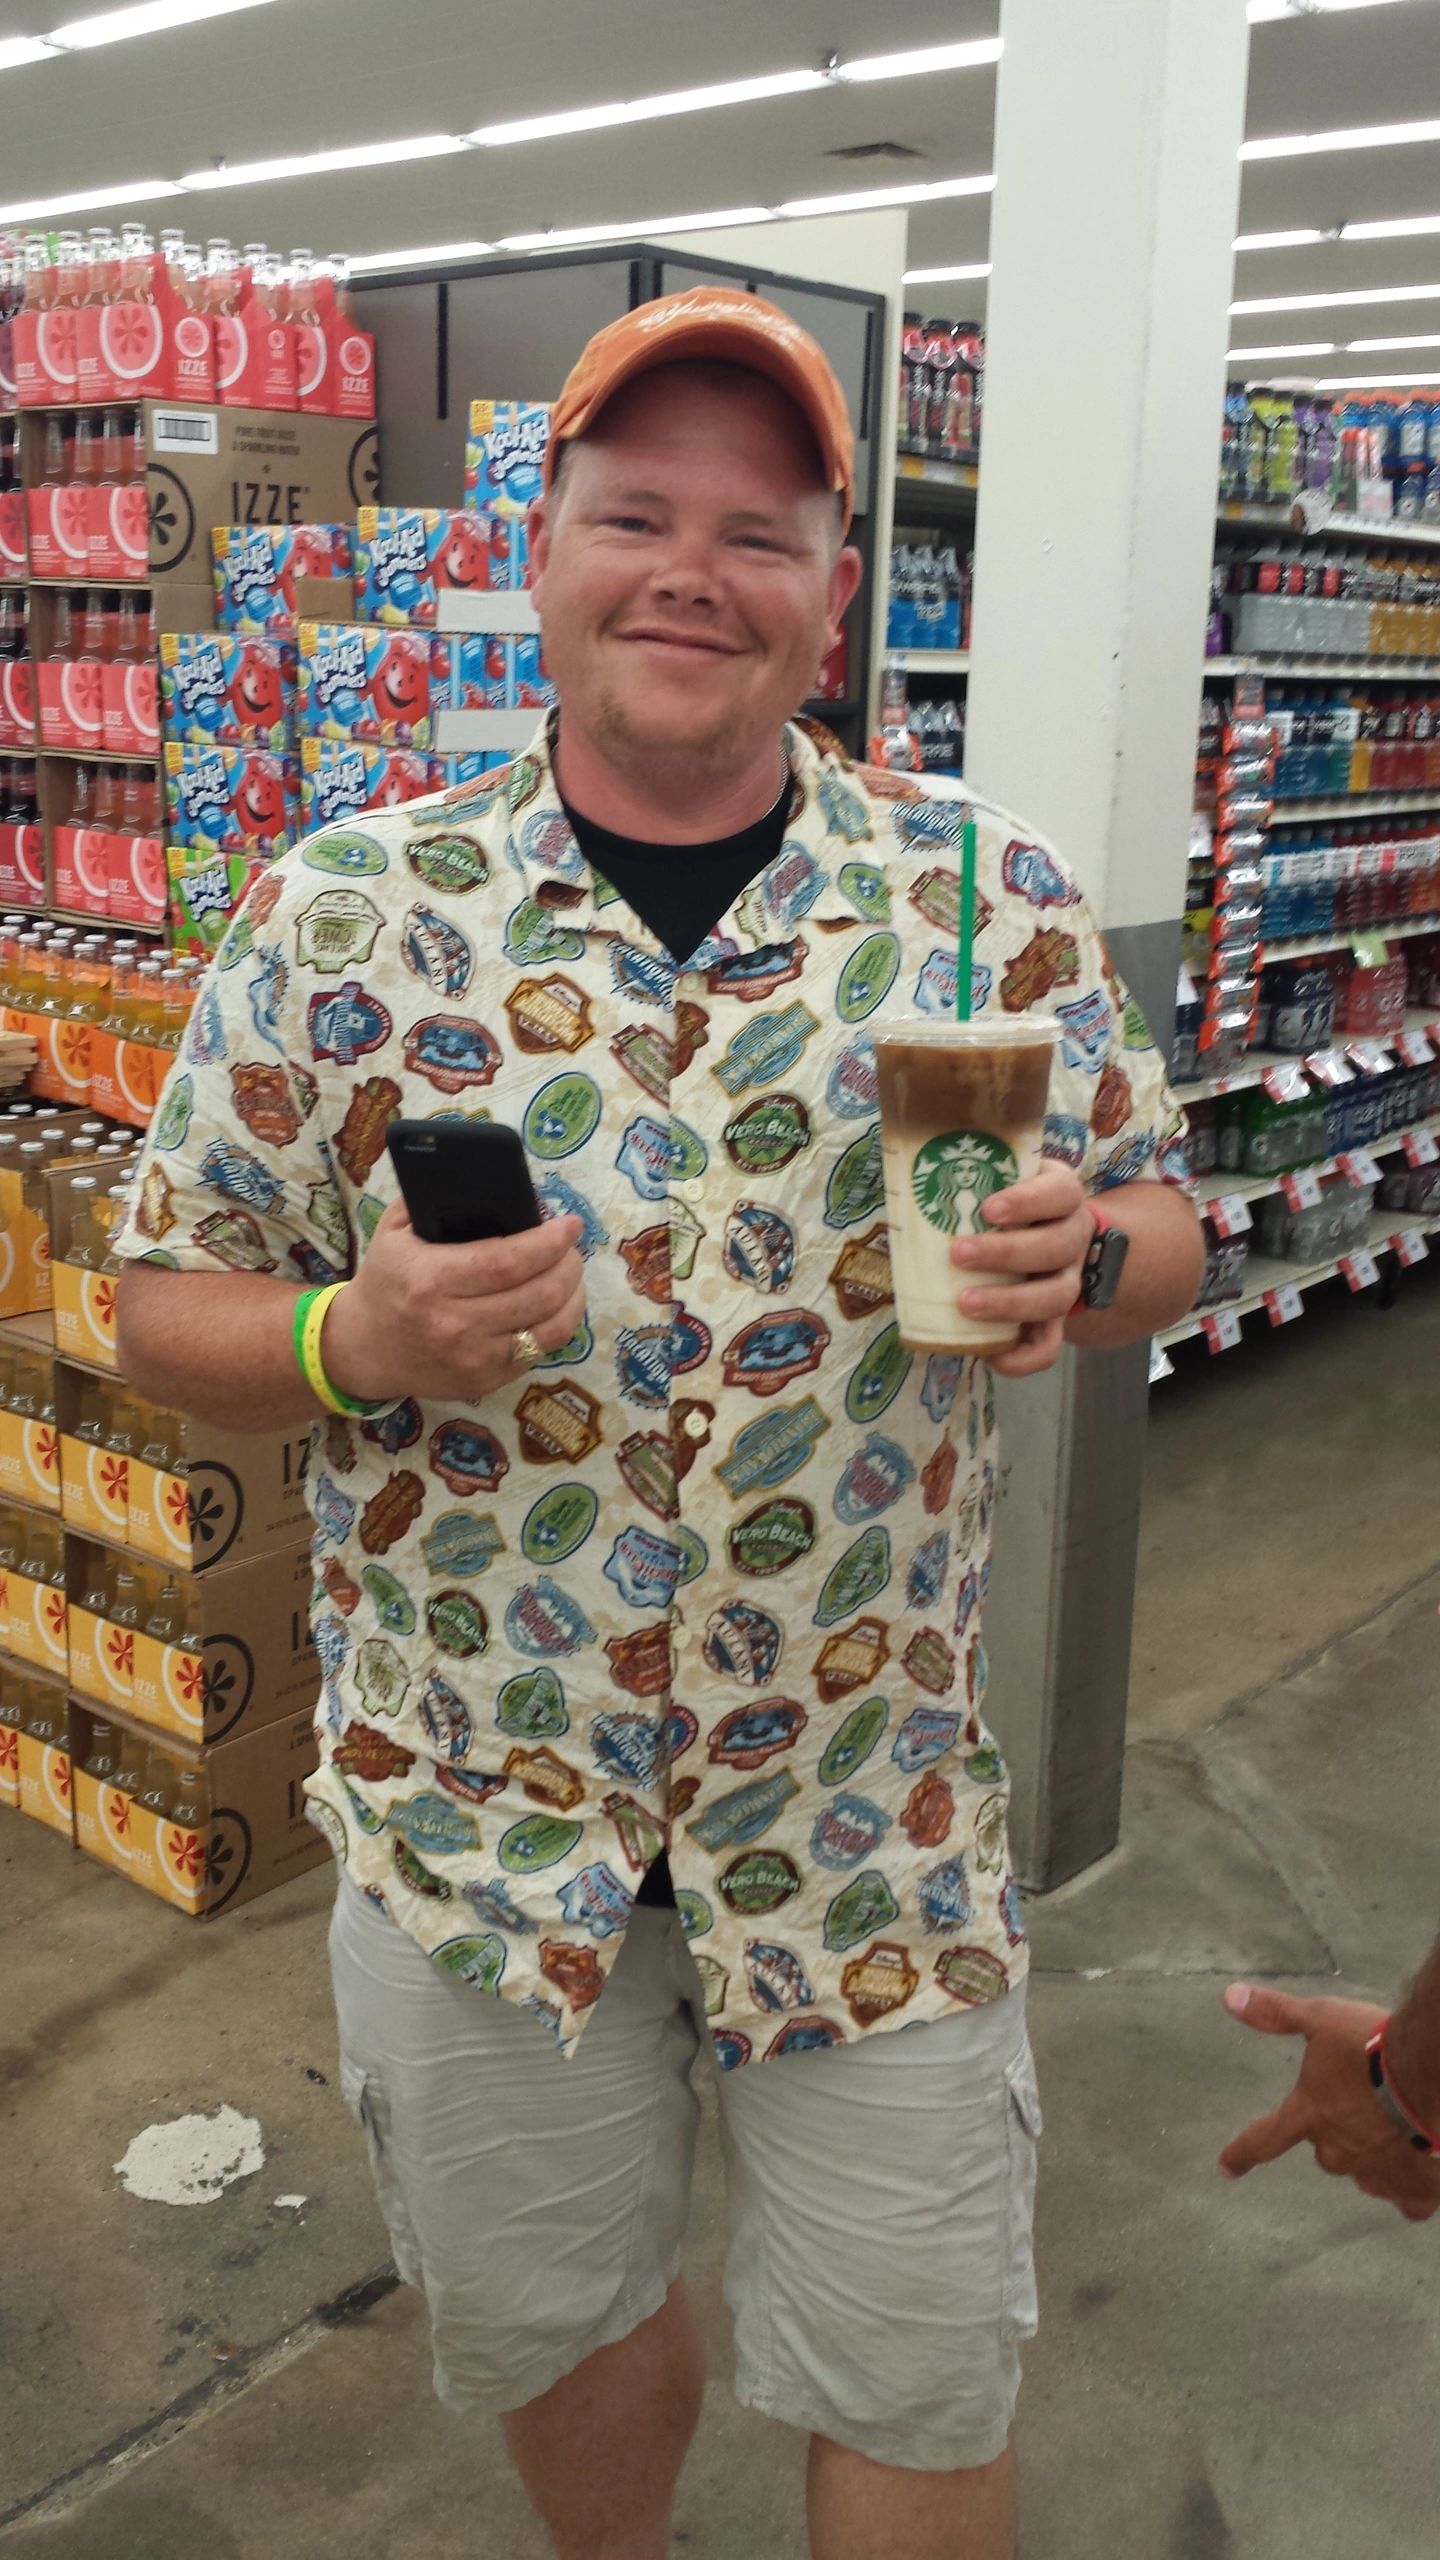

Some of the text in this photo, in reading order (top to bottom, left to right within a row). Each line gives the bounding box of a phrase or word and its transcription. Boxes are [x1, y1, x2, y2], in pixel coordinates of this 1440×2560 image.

[231, 481, 304, 526] IZZE
[725, 1119, 810, 1147] VERO BEACH
[732, 1523, 813, 1551] VERO BEACH
[720, 1870, 800, 1892] VERO BEACH
